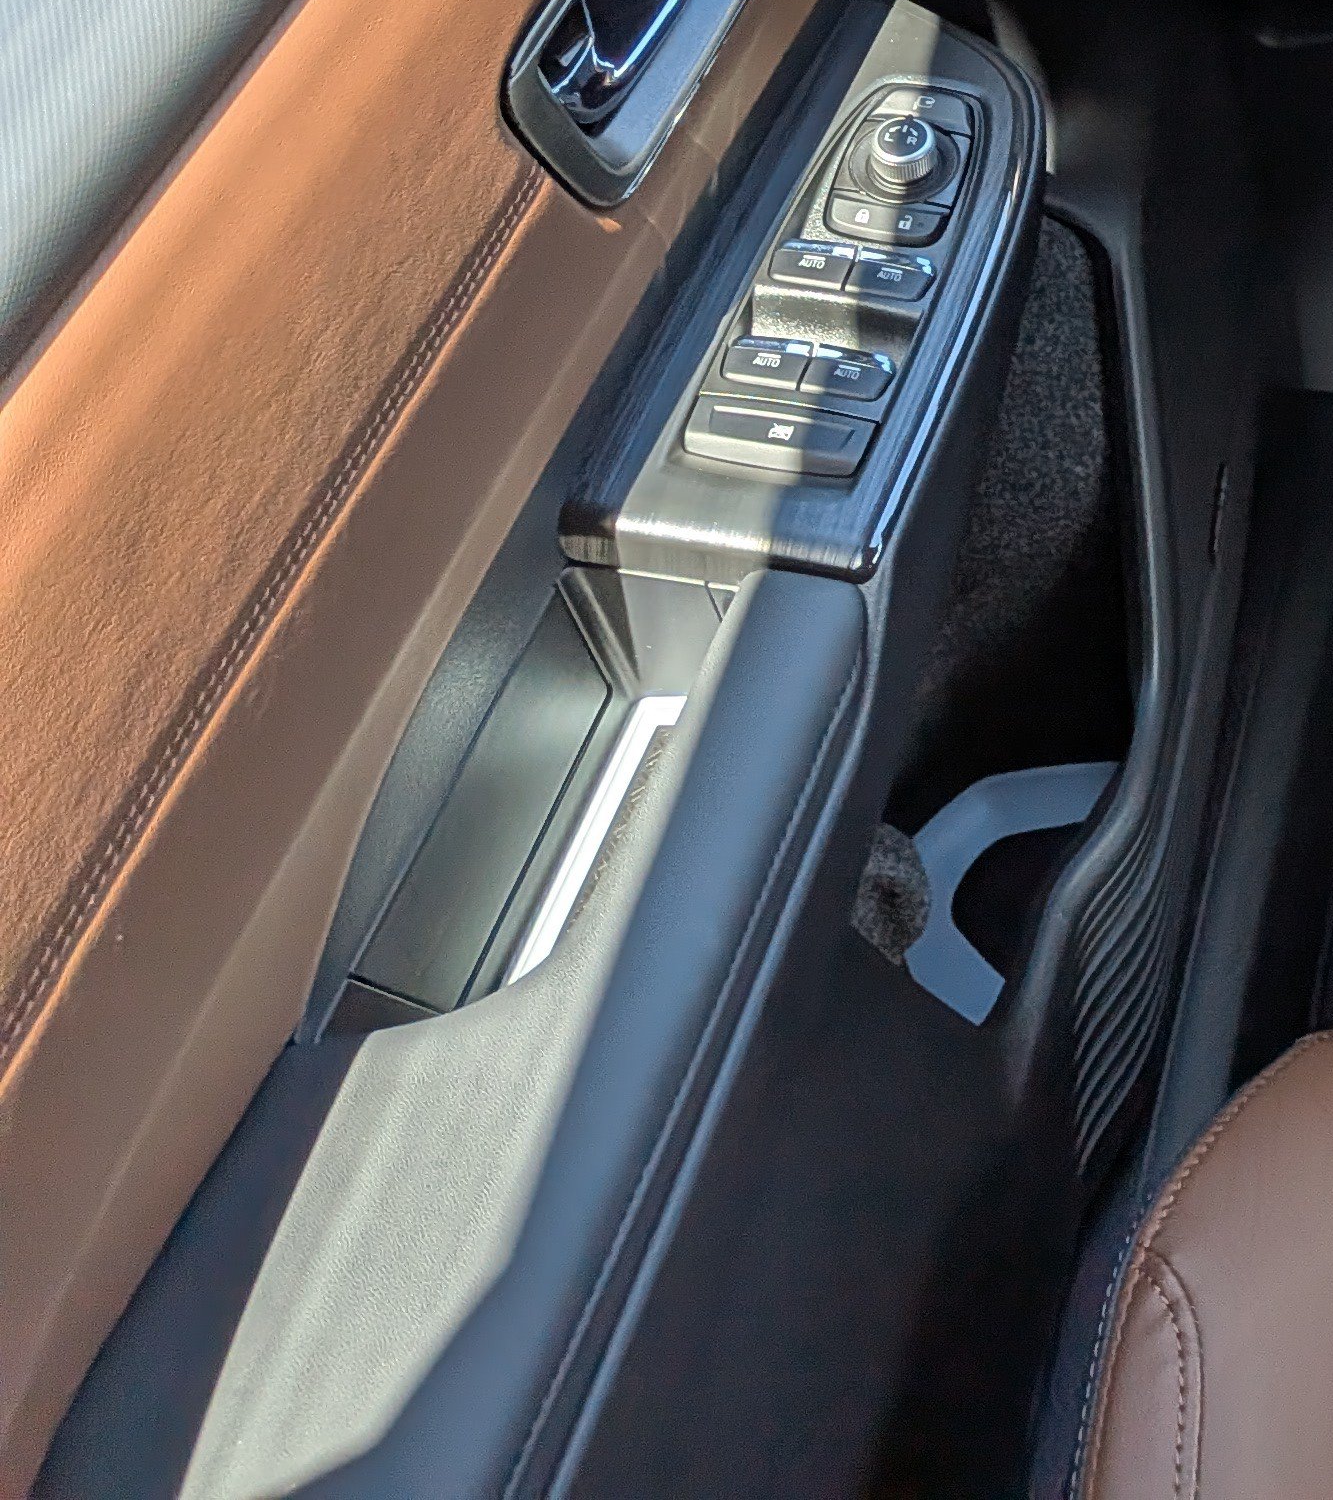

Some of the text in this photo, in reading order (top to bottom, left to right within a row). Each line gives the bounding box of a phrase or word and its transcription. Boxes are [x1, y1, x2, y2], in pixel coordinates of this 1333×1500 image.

[906, 136, 918, 145] R
[798, 257, 825, 269] AUTO
[876, 269, 902, 282] AUTO
[752, 356, 780, 368] AUTO
[832, 367, 860, 380] AUTO
